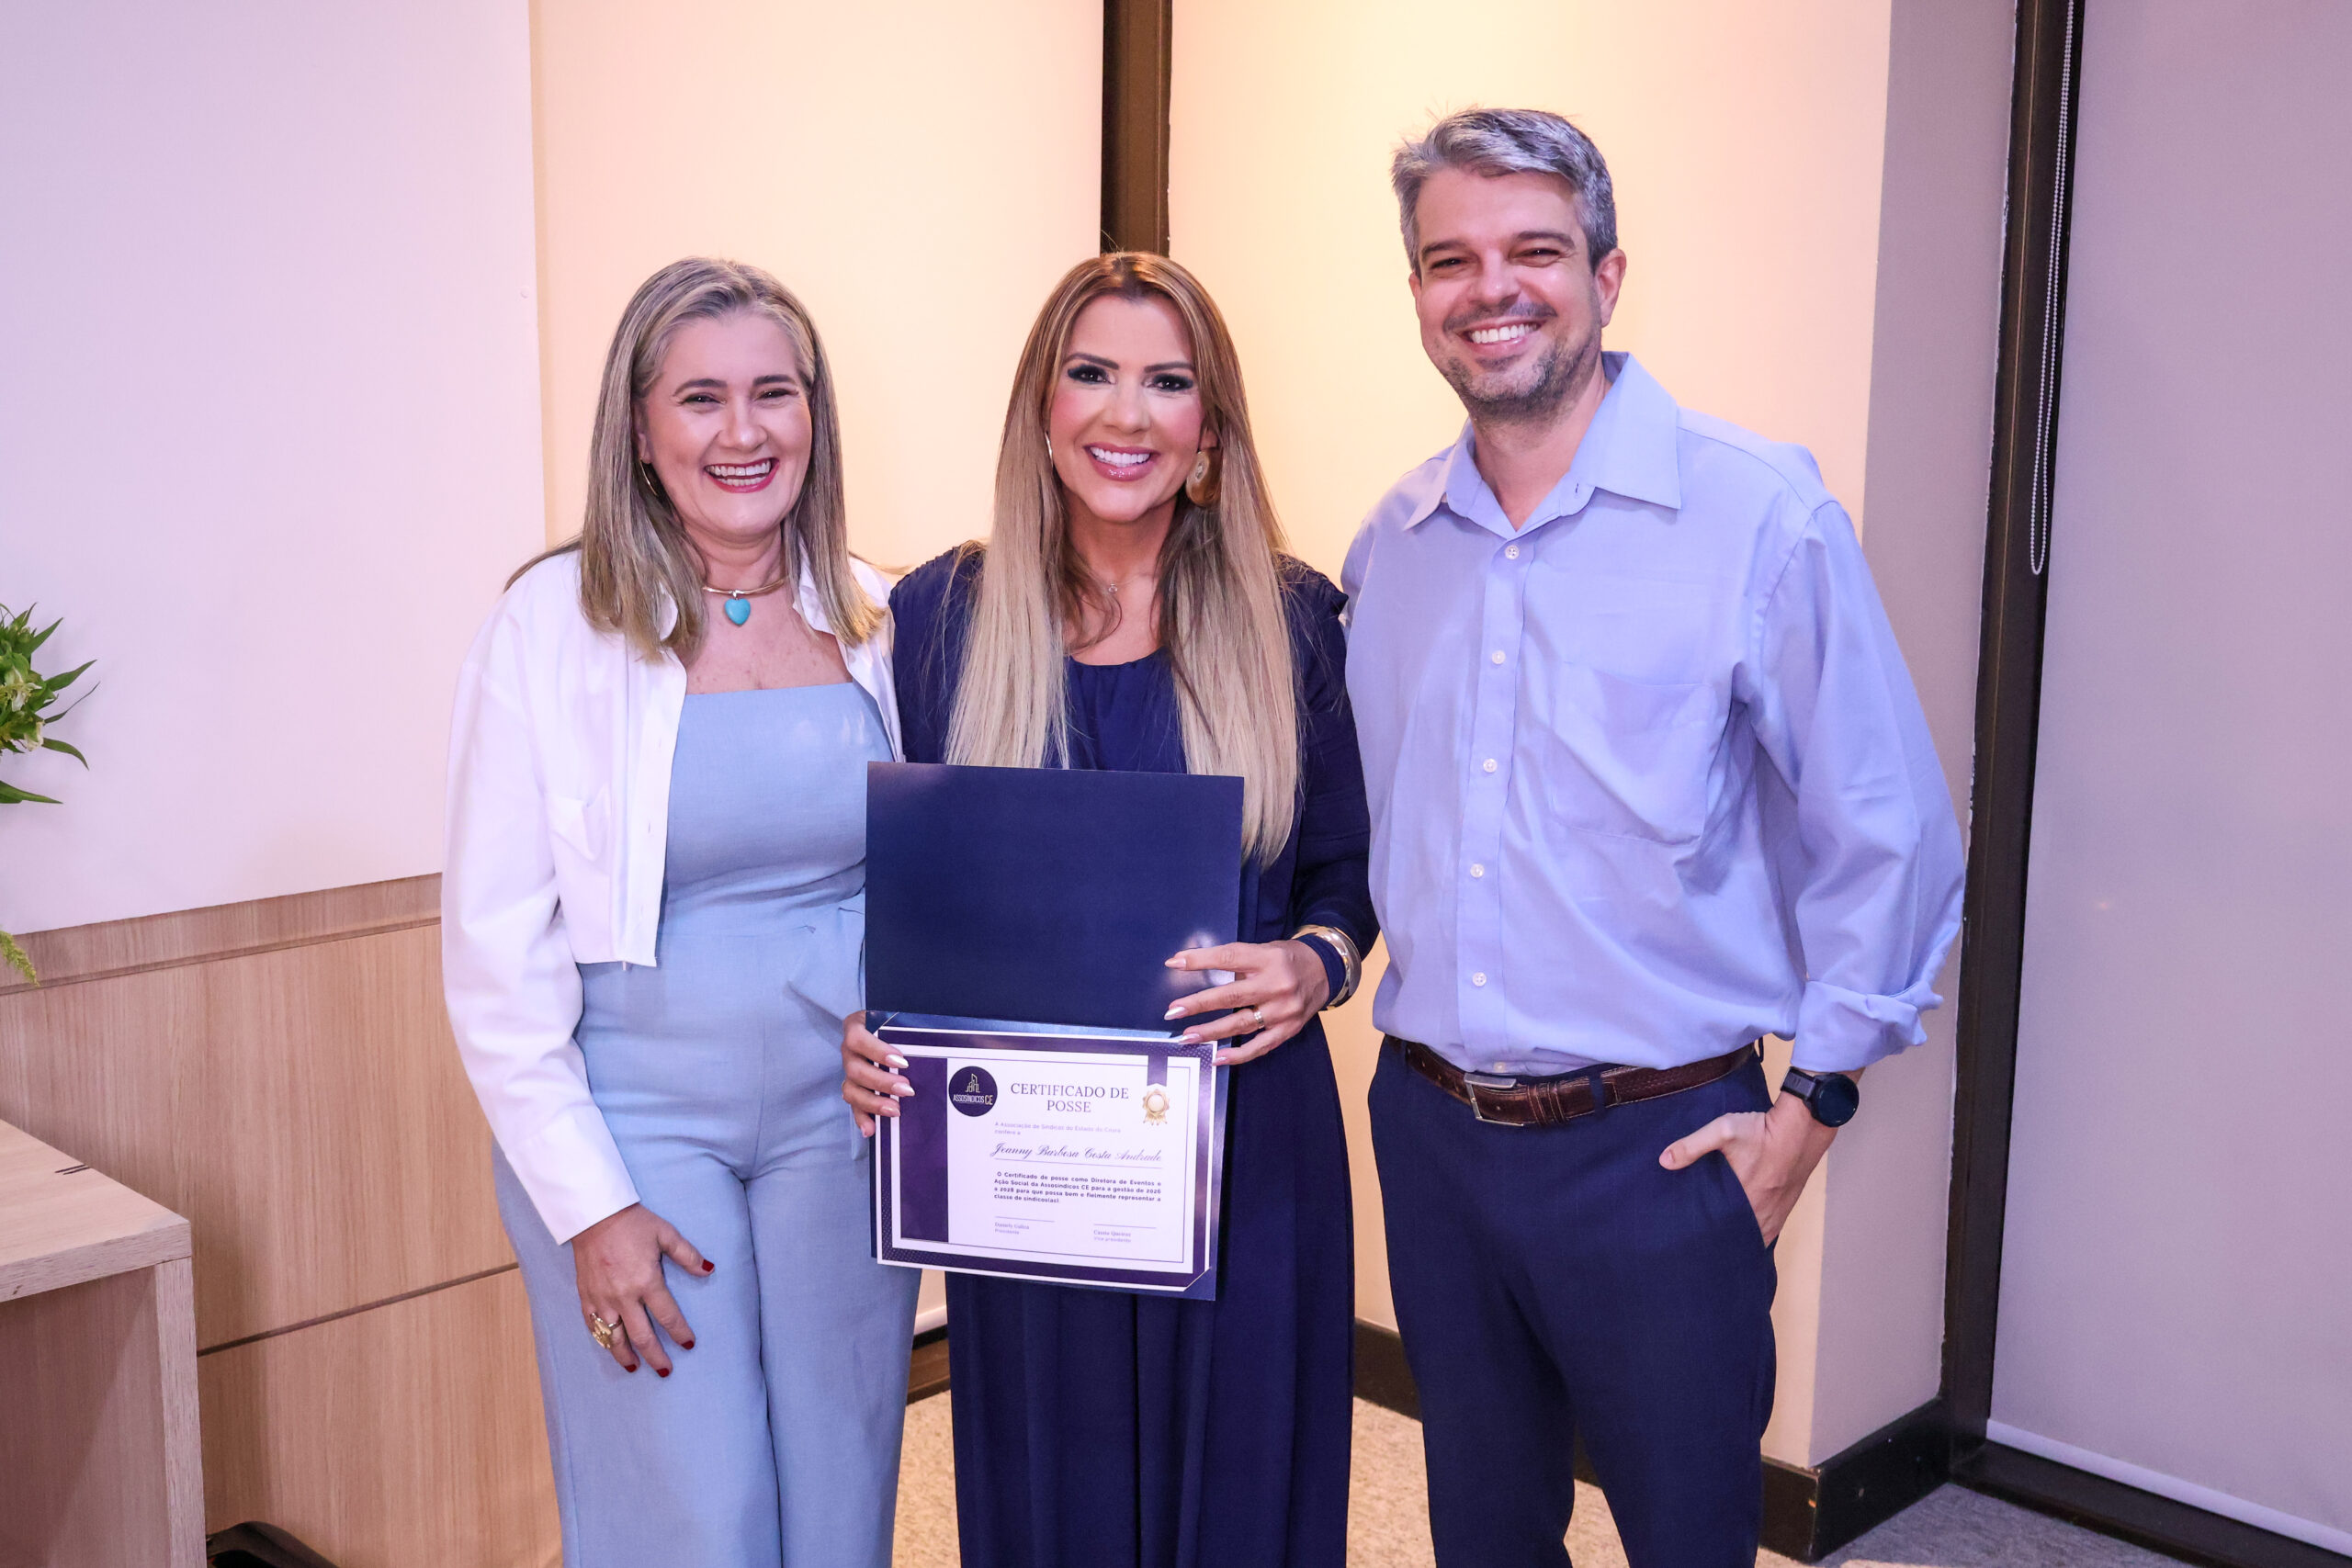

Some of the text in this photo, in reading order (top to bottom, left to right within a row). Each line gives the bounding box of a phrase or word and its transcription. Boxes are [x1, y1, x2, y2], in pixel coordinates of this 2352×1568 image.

[1011, 1083, 1129, 1100] CERTIFICADO DE
[1047, 1100, 1091, 1113] POSSE
[1035, 1145, 1080, 1157] Barbosa
[1084, 1147, 1111, 1159] Costa
[1115, 1149, 1161, 1162] Andrade
